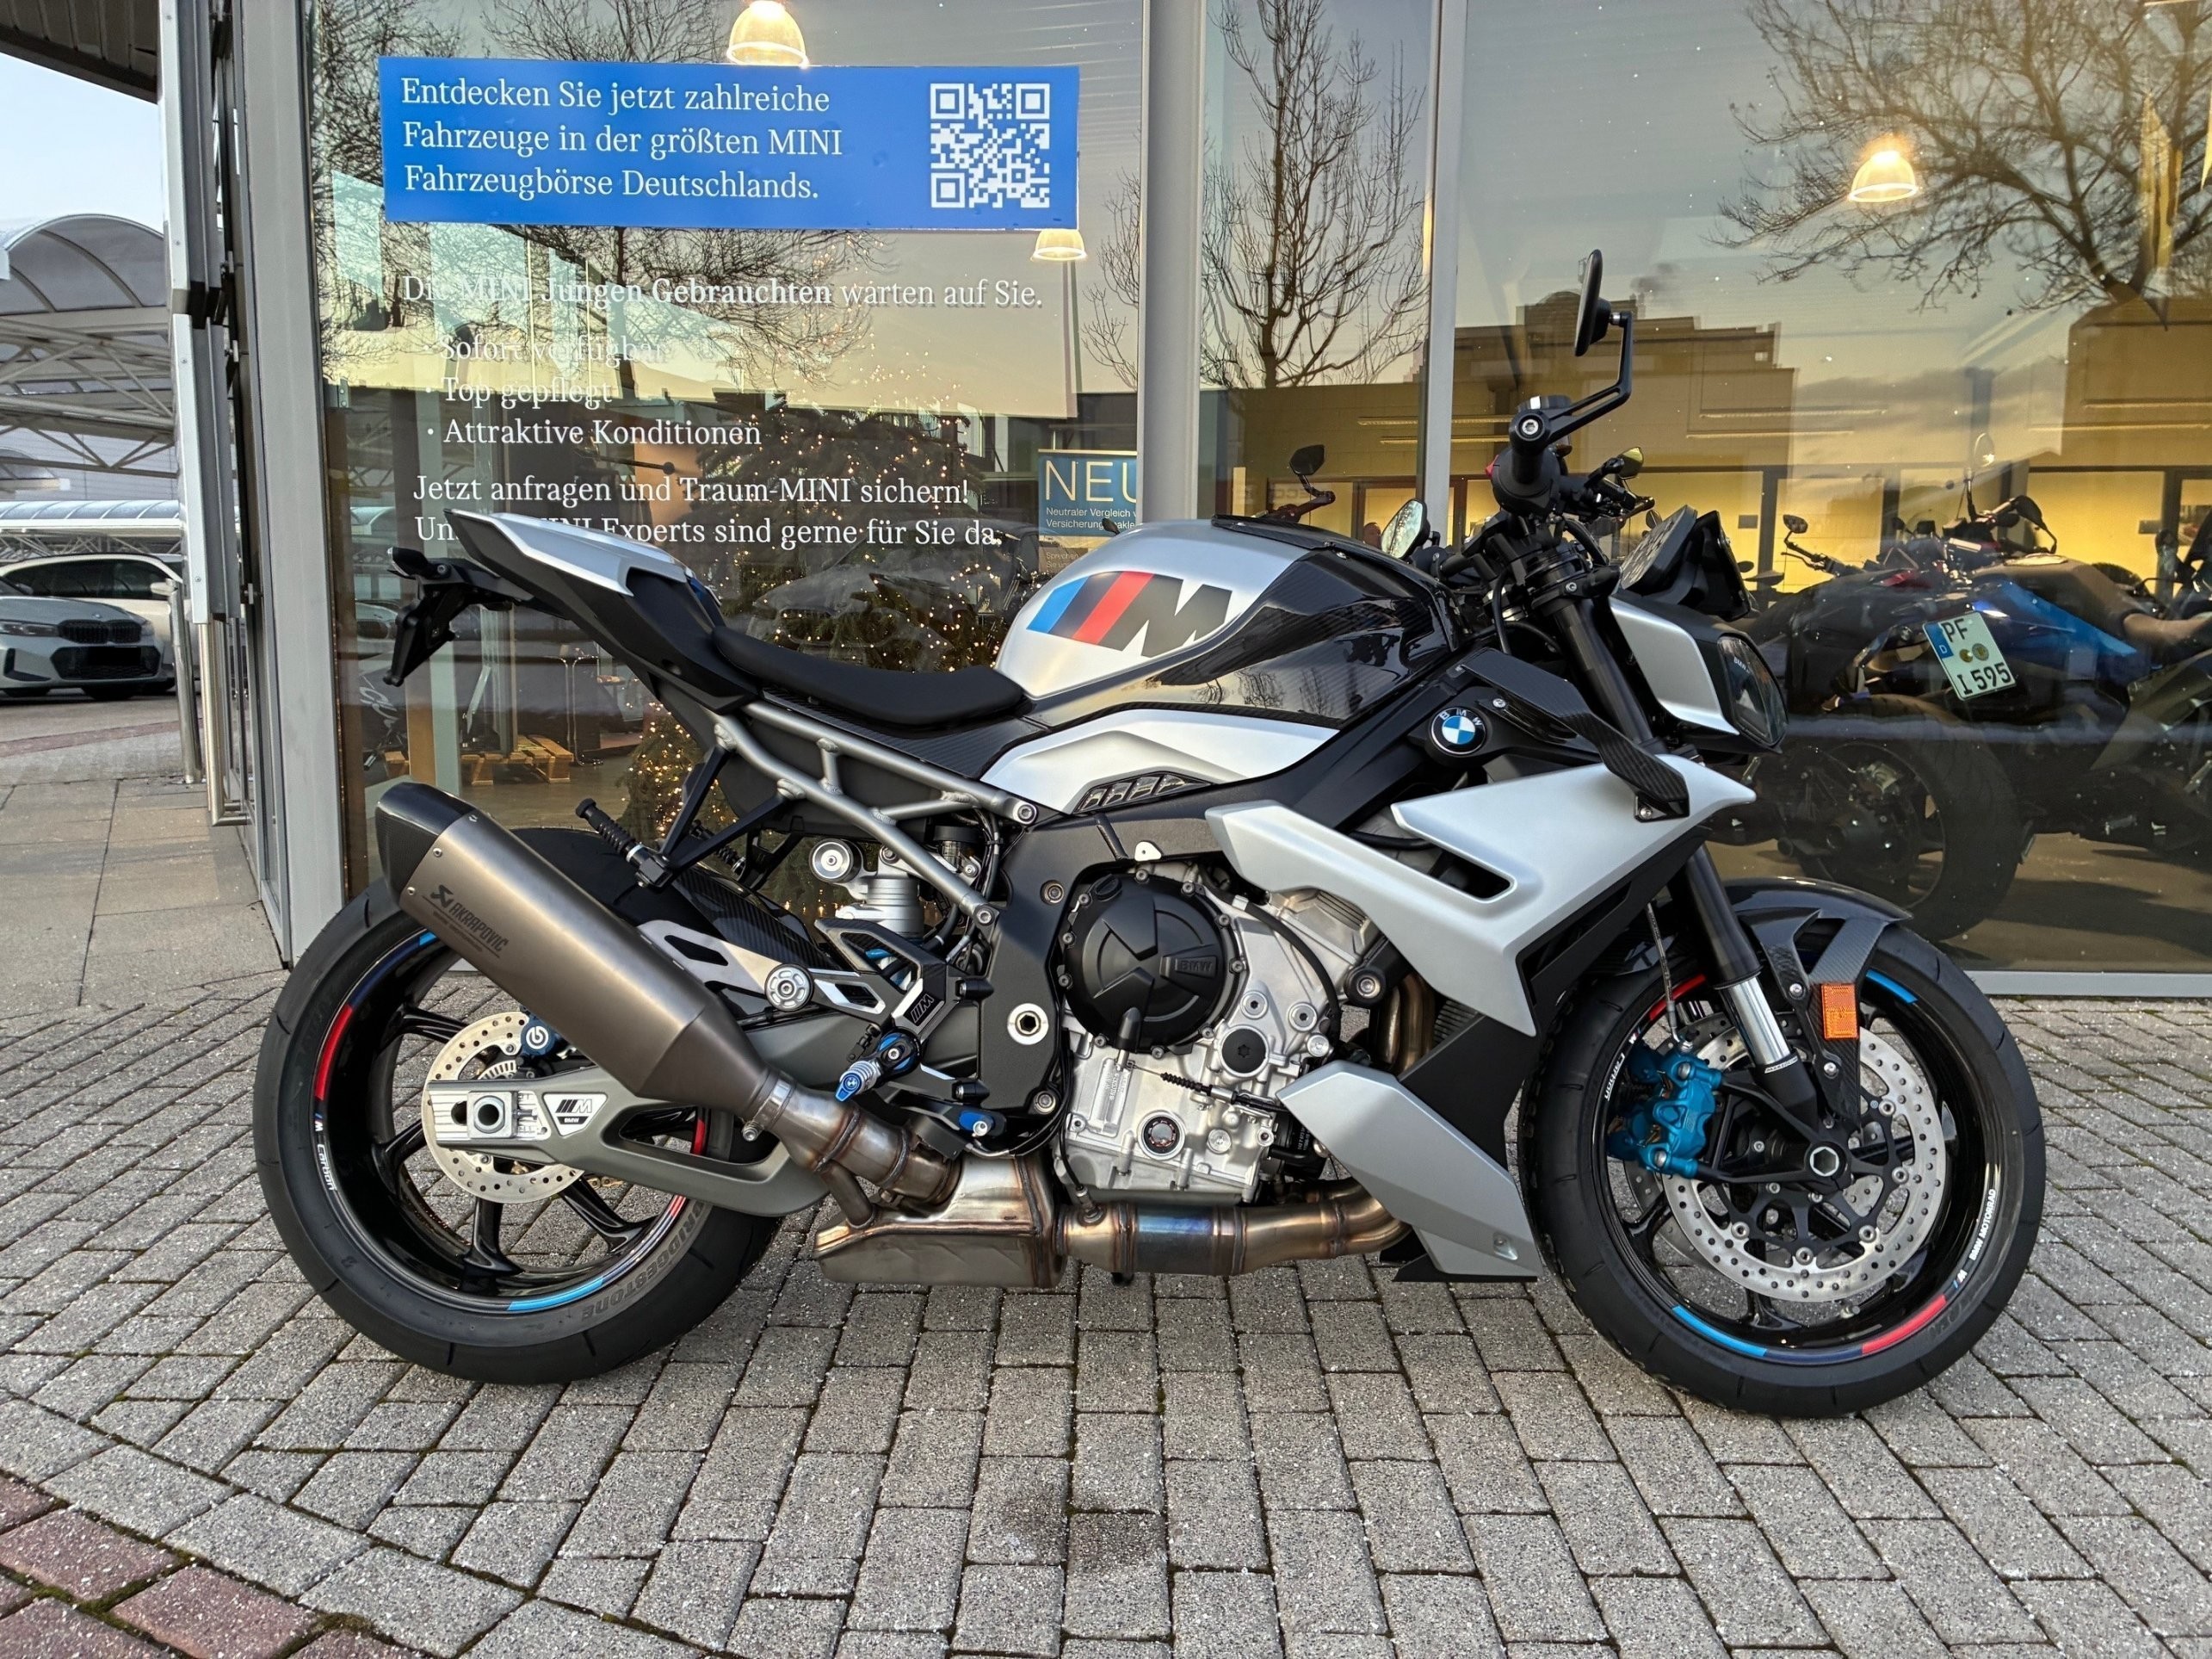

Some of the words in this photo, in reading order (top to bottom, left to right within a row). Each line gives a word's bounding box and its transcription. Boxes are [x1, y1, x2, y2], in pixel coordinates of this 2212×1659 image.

[400, 77, 551, 107] Entdecken
[559, 80, 602, 108] Sie
[608, 82, 676, 116] jetzt
[684, 84, 830, 112] zahlreiche
[403, 121, 550, 158] Fahrzeuge
[559, 125, 587, 151] in
[596, 125, 641, 152] der
[651, 127, 759, 161] größten
[768, 129, 843, 155] MINI
[405, 164, 613, 201] Fahrzeugbörse
[621, 170, 819, 199] Deutschlands.
[460, 276, 530, 301] MINI
[541, 277, 642, 309] Jungen
[652, 277, 832, 306] Gebrauchten
[841, 284, 934, 306] warten
[944, 280, 987, 306] auf
[995, 280, 1043, 307] Sie.
[439, 334, 523, 360] Sofort
[442, 377, 491, 409] Top
[500, 376, 613, 411] gepflegt
[443, 418, 584, 445] Attraktive
[592, 418, 762, 446] Konditionen
[413, 474, 482, 500] Jetzt
[490, 474, 612, 508] anfragen
[620, 476, 672, 502] und
[678, 477, 851, 503] Traum-MINI
[860, 478, 969, 504] sichern!
[1046, 507, 1088, 517] Neutraler
[1090, 508, 1131, 519] Vergleich
[714, 518, 771, 543] sind
[781, 523, 857, 550] gerne
[866, 518, 907, 544] für
[915, 520, 955, 544] Sie
[1941, 618, 1968, 643] PF
[1938, 644, 1948, 654] D
[1970, 662, 2011, 690] 595
[1439, 708, 1482, 727] BMW
[1968, 1236, 1984, 1261] BMW
[1978, 1188, 1997, 1239] MOTORRAD
